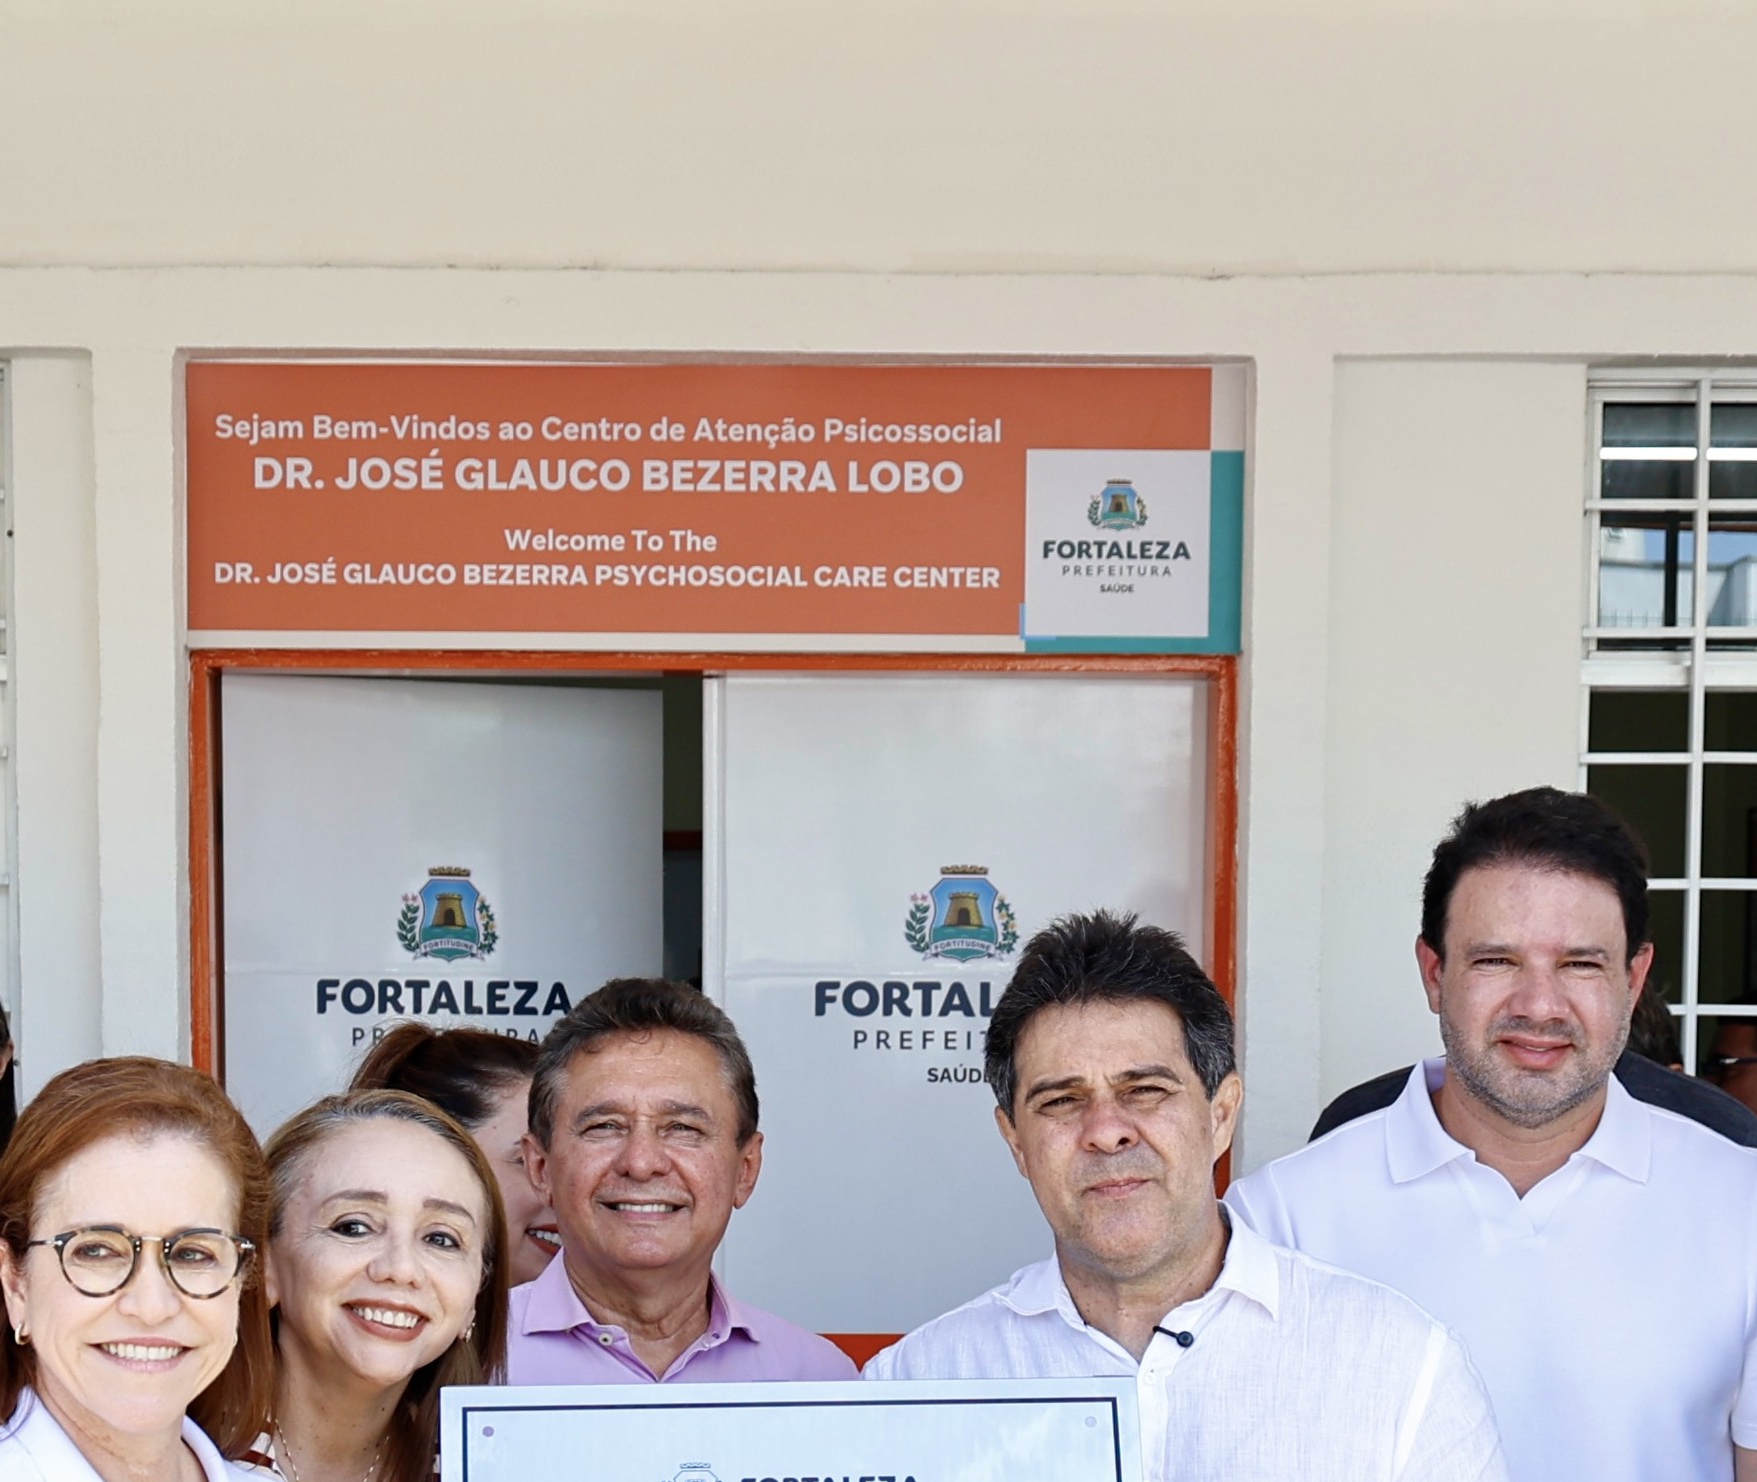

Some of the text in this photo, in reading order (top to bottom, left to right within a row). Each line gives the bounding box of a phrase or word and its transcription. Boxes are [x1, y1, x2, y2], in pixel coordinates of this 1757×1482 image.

[215, 414, 1002, 448] Sejam Bem-Vindos ao Centro de Atenção Psicossocial
[254, 448, 964, 493] DR. JOSÉ GLAUCO BEZERRA LOBO
[504, 529, 717, 552] Welcome To The
[1043, 540, 1191, 560] FORTALEZA
[214, 557, 1000, 588] DR. JOSÉ GLAUCO BEZERRA PSYCHOSOCIAL CARE CENTER
[1062, 565, 1172, 577] PREFEITURA
[1100, 582, 1134, 593] SAÚDE
[423, 939, 475, 952] FORTITUDINE
[934, 939, 992, 952] FORTITUDINE
[316, 979, 573, 1016] FORTALEZA
[814, 981, 997, 1017] FORTAL
[853, 1030, 987, 1050] PREFEI
